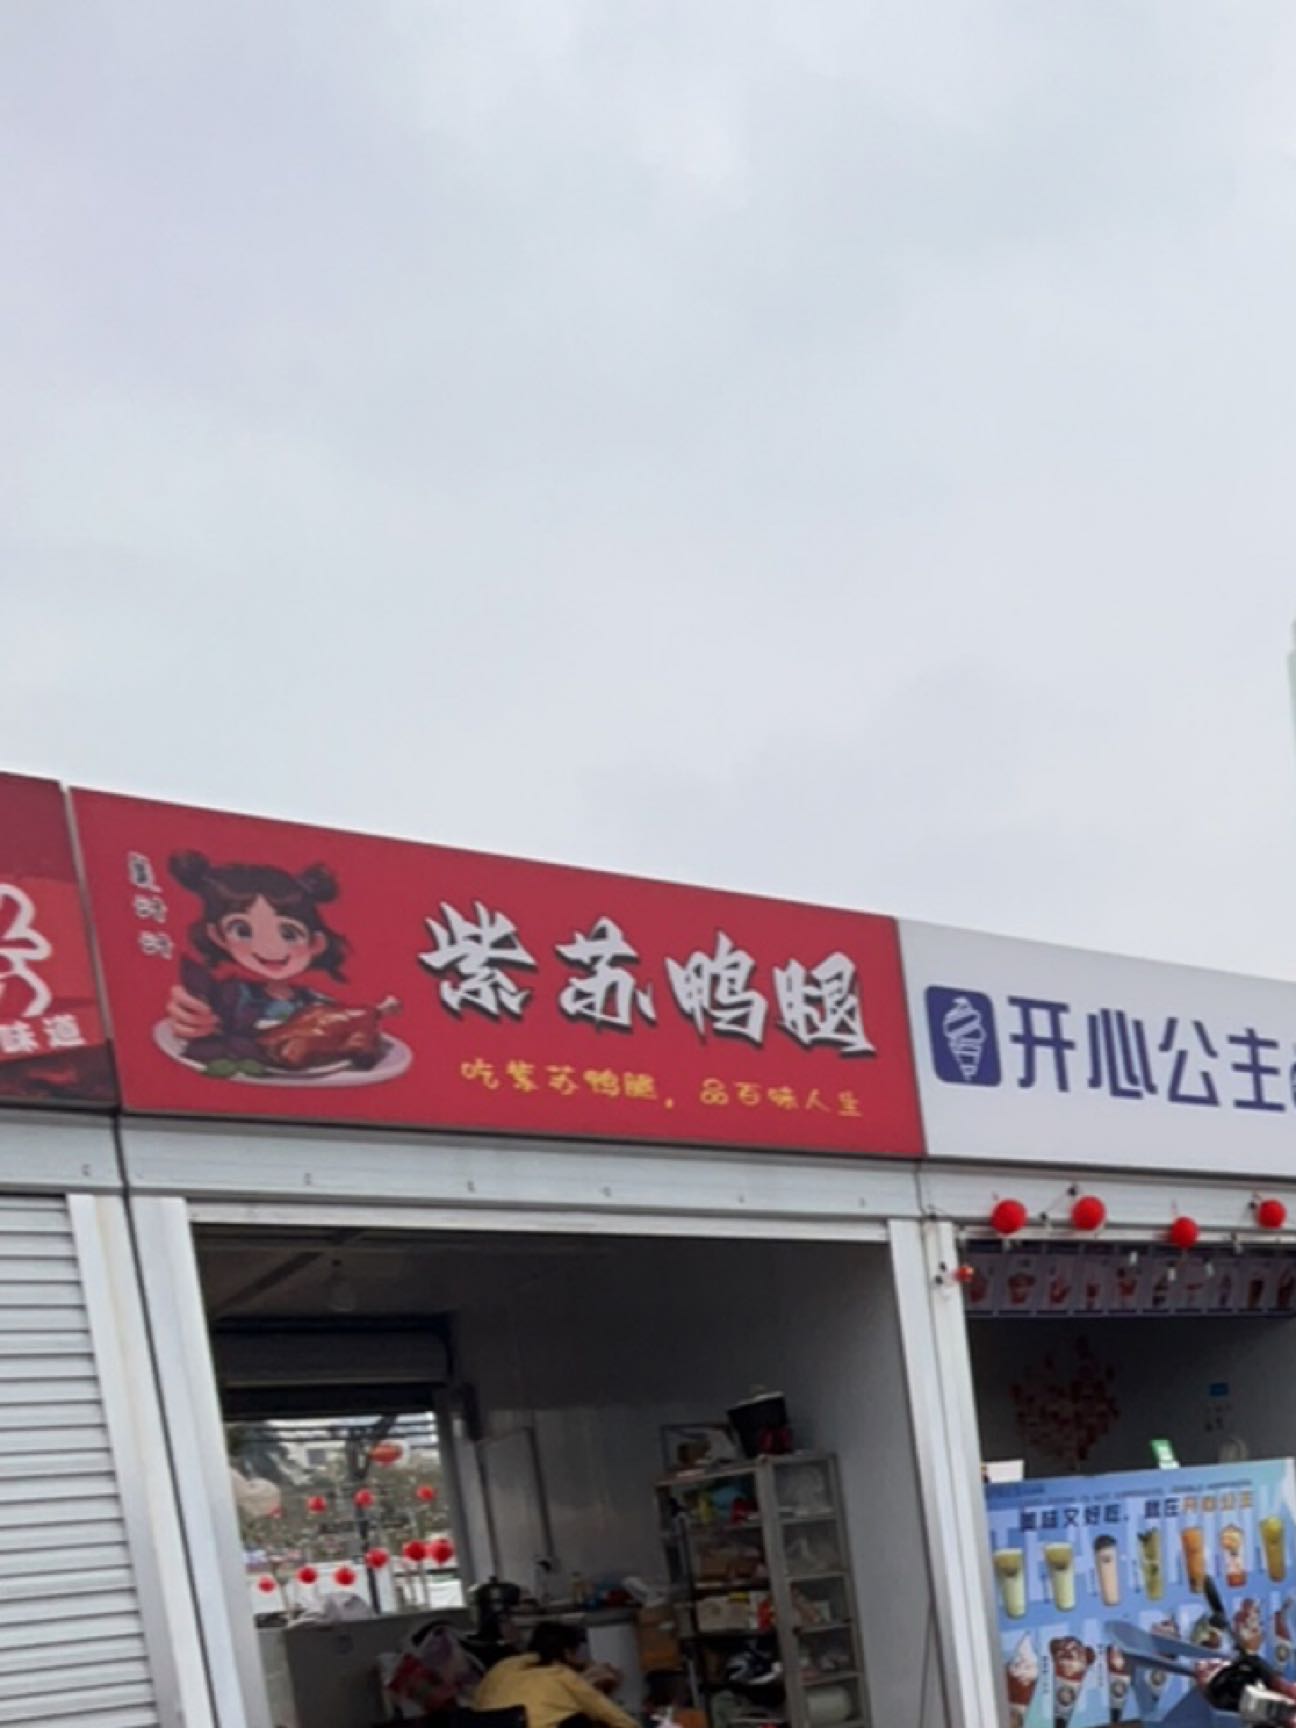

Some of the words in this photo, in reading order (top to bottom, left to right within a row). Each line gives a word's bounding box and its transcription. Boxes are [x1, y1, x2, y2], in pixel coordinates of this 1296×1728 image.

[418, 899, 877, 1059] 紫苏鸭腿
[1007, 994, 1287, 1112] 开心公主
